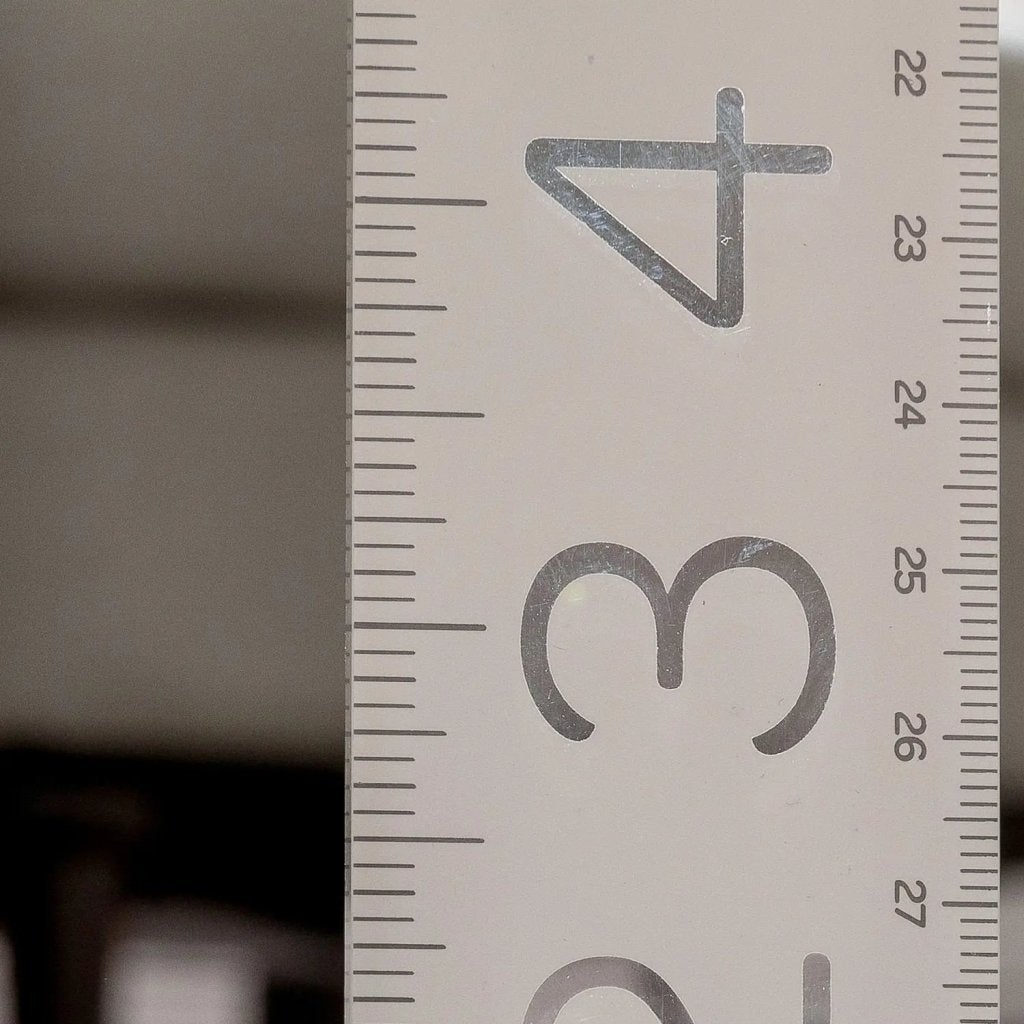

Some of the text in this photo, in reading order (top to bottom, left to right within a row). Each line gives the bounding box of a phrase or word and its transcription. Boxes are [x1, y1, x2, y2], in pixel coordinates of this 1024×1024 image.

[893, 48, 928, 98] 22
[524, 86, 833, 329] 4
[893, 213, 928, 264] 23
[893, 379, 928, 430] 24
[893, 546, 928, 596] 25
[520, 535, 837, 756] 3
[893, 711, 928, 763] 26
[893, 878, 928, 930] 27
